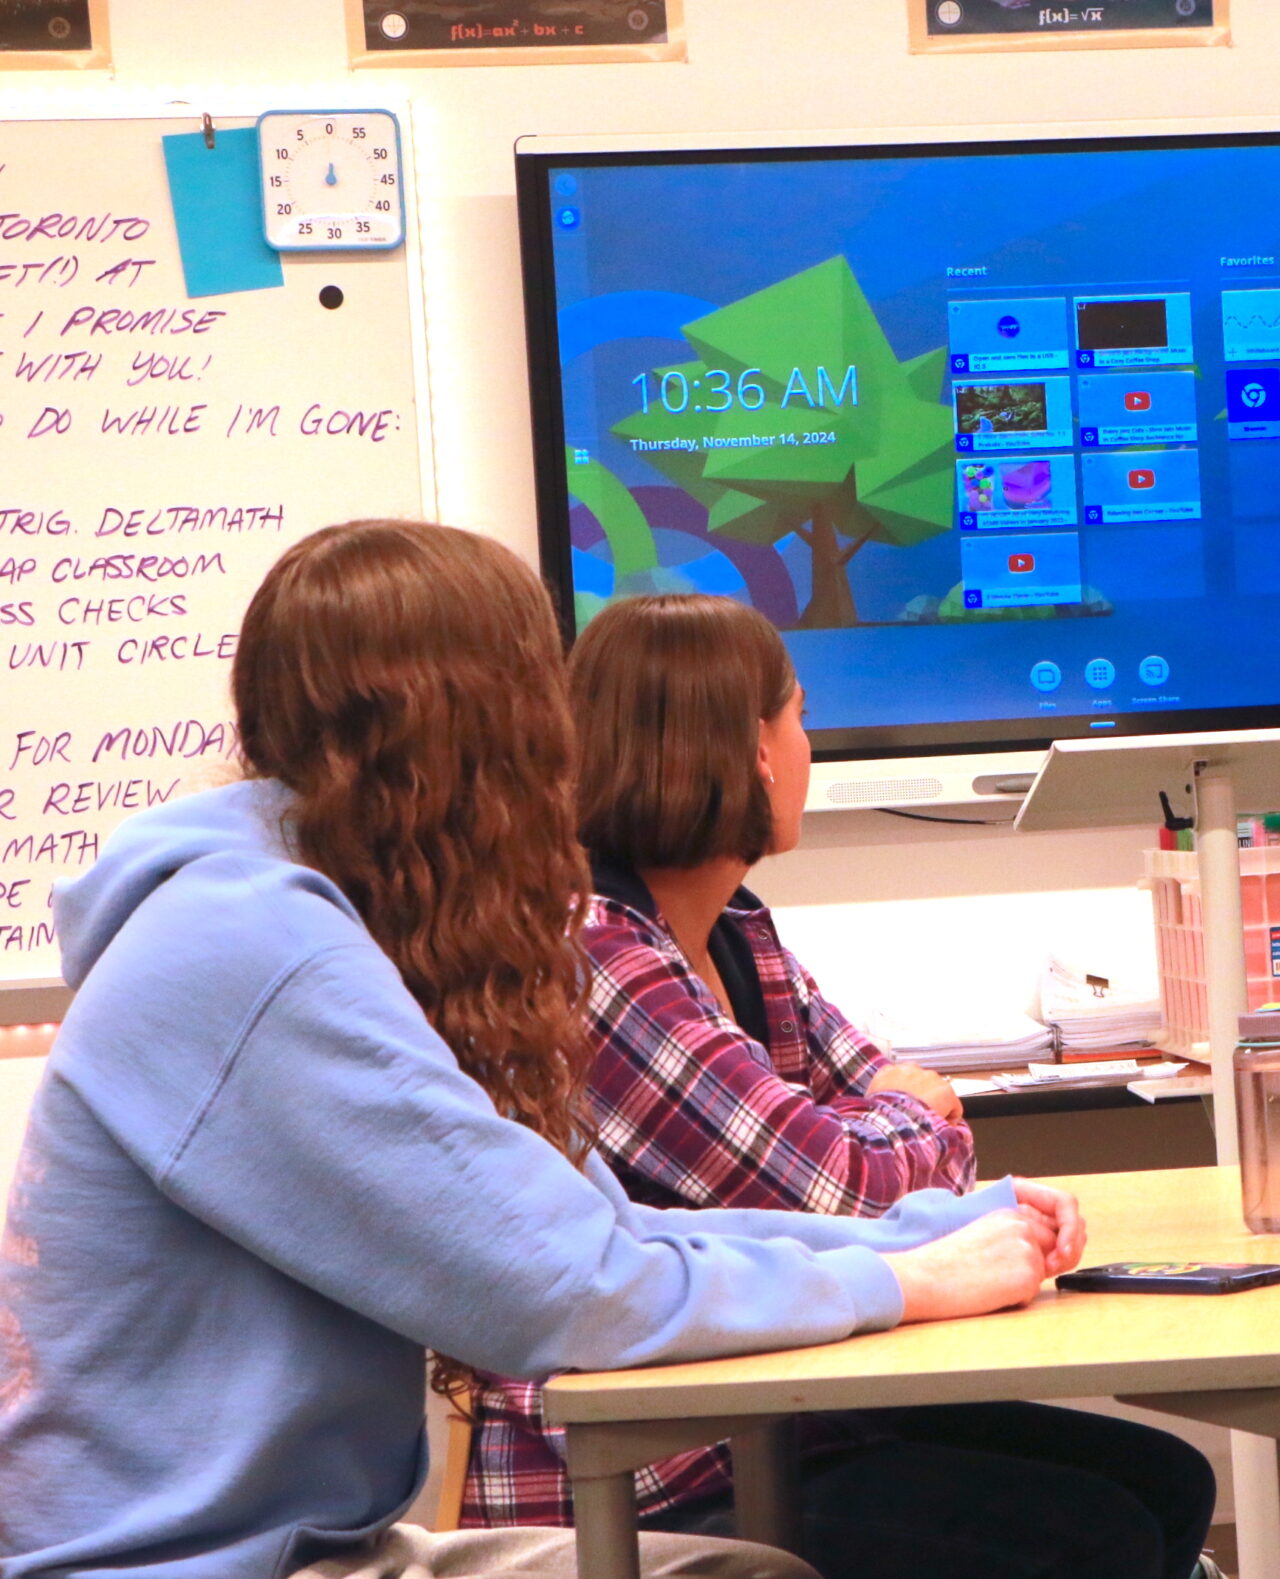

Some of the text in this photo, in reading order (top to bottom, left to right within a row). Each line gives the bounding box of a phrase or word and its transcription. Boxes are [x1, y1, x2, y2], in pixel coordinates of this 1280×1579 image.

[296, 129, 304, 141] 5
[325, 123, 333, 135] 0
[352, 127, 366, 139] 55
[276, 148, 289, 160] 10
[373, 148, 388, 160] 50
[270, 176, 282, 187] 15
[380, 173, 395, 185] 45
[277, 204, 292, 215] 20
[375, 200, 390, 211] 40
[298, 223, 313, 235] 25
[356, 221, 370, 233] 35
[327, 228, 342, 239] 30
[1220, 255, 1275, 267] Favorites
[95, 258, 157, 288] AT
[946, 265, 988, 277] Recent
[60, 306, 228, 337] PROMISE
[15, 350, 213, 387] WITH YOU!
[631, 364, 859, 415] 10:36 AM
[27, 406, 72, 439] DO
[101, 403, 209, 437] WHILE
[226, 403, 281, 438] I'M
[300, 402, 401, 443] GONE:
[629, 431, 837, 453] Thursday, November 14, 2024
[0, 504, 284, 538] TRIG. DELTAMATH
[51, 552, 227, 584] CLASSROOM
[58, 594, 188, 625] CHECKS
[9, 633, 240, 671] UNIT CIRCLE
[9, 730, 72, 771] FOR
[42, 778, 181, 816] REVIEW
[2, 831, 99, 865] MATH
